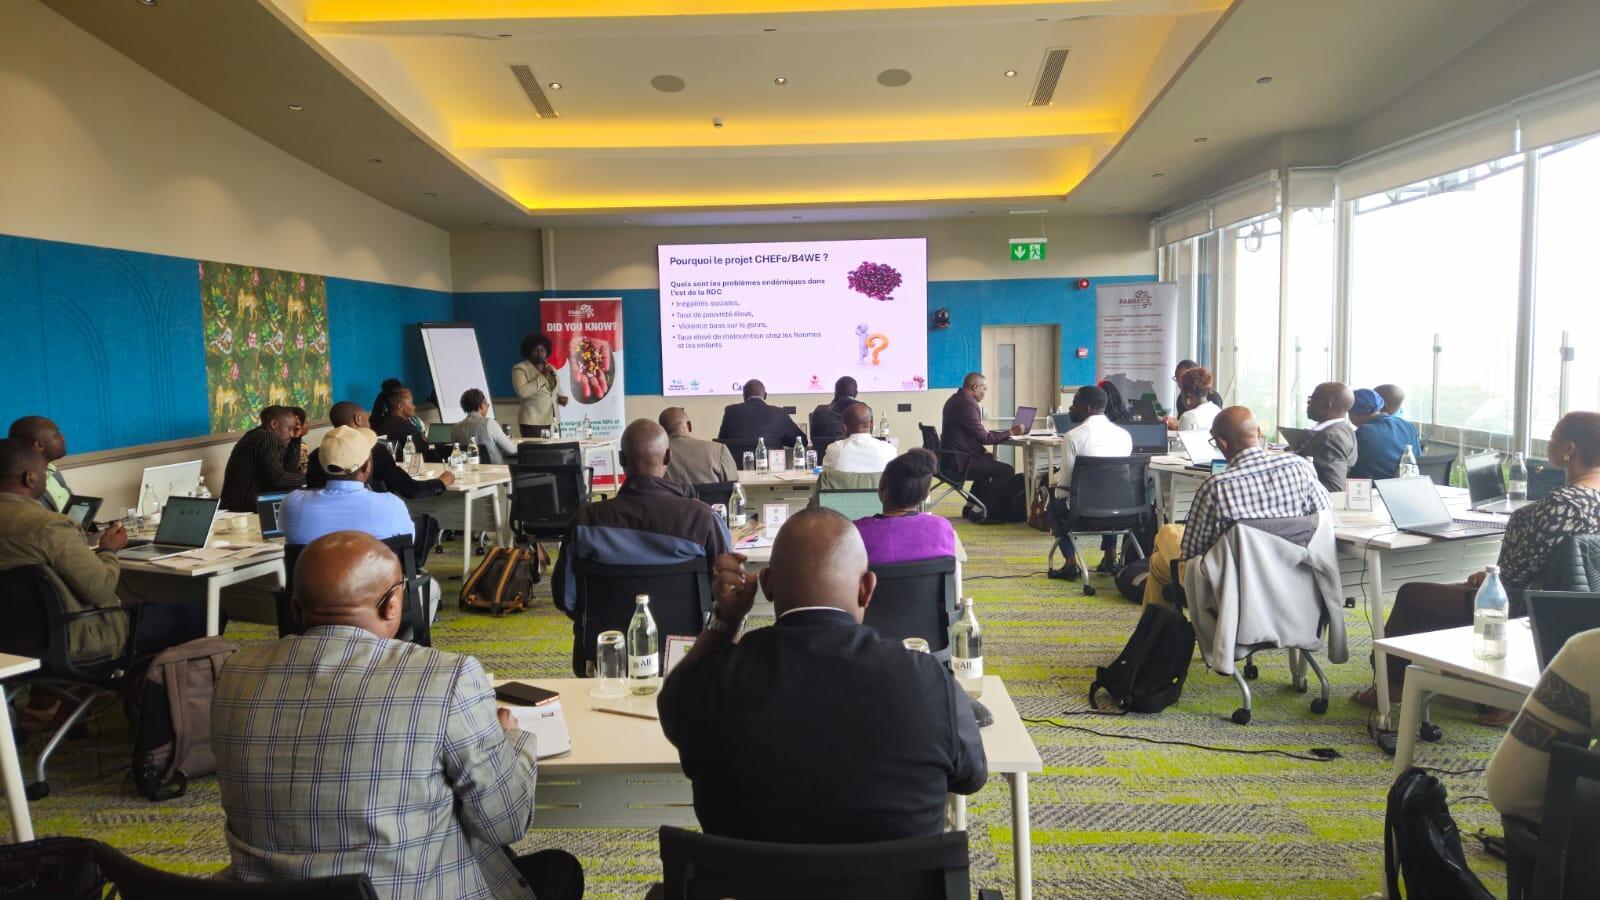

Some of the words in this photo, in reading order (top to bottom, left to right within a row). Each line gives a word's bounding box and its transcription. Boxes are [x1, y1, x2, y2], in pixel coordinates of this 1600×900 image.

[670, 256, 712, 266] Pourquoi
[713, 256, 723, 264] le
[724, 255, 753, 266] projet
[754, 254, 821, 263] CHEFe/B4WE
[722, 279, 760, 288] problèmes
[762, 278, 806, 286] endémiques
[546, 322, 563, 332] DID
[564, 322, 583, 332] YOU
[584, 321, 617, 332] KNOW?
[732, 382, 745, 391] Ca
